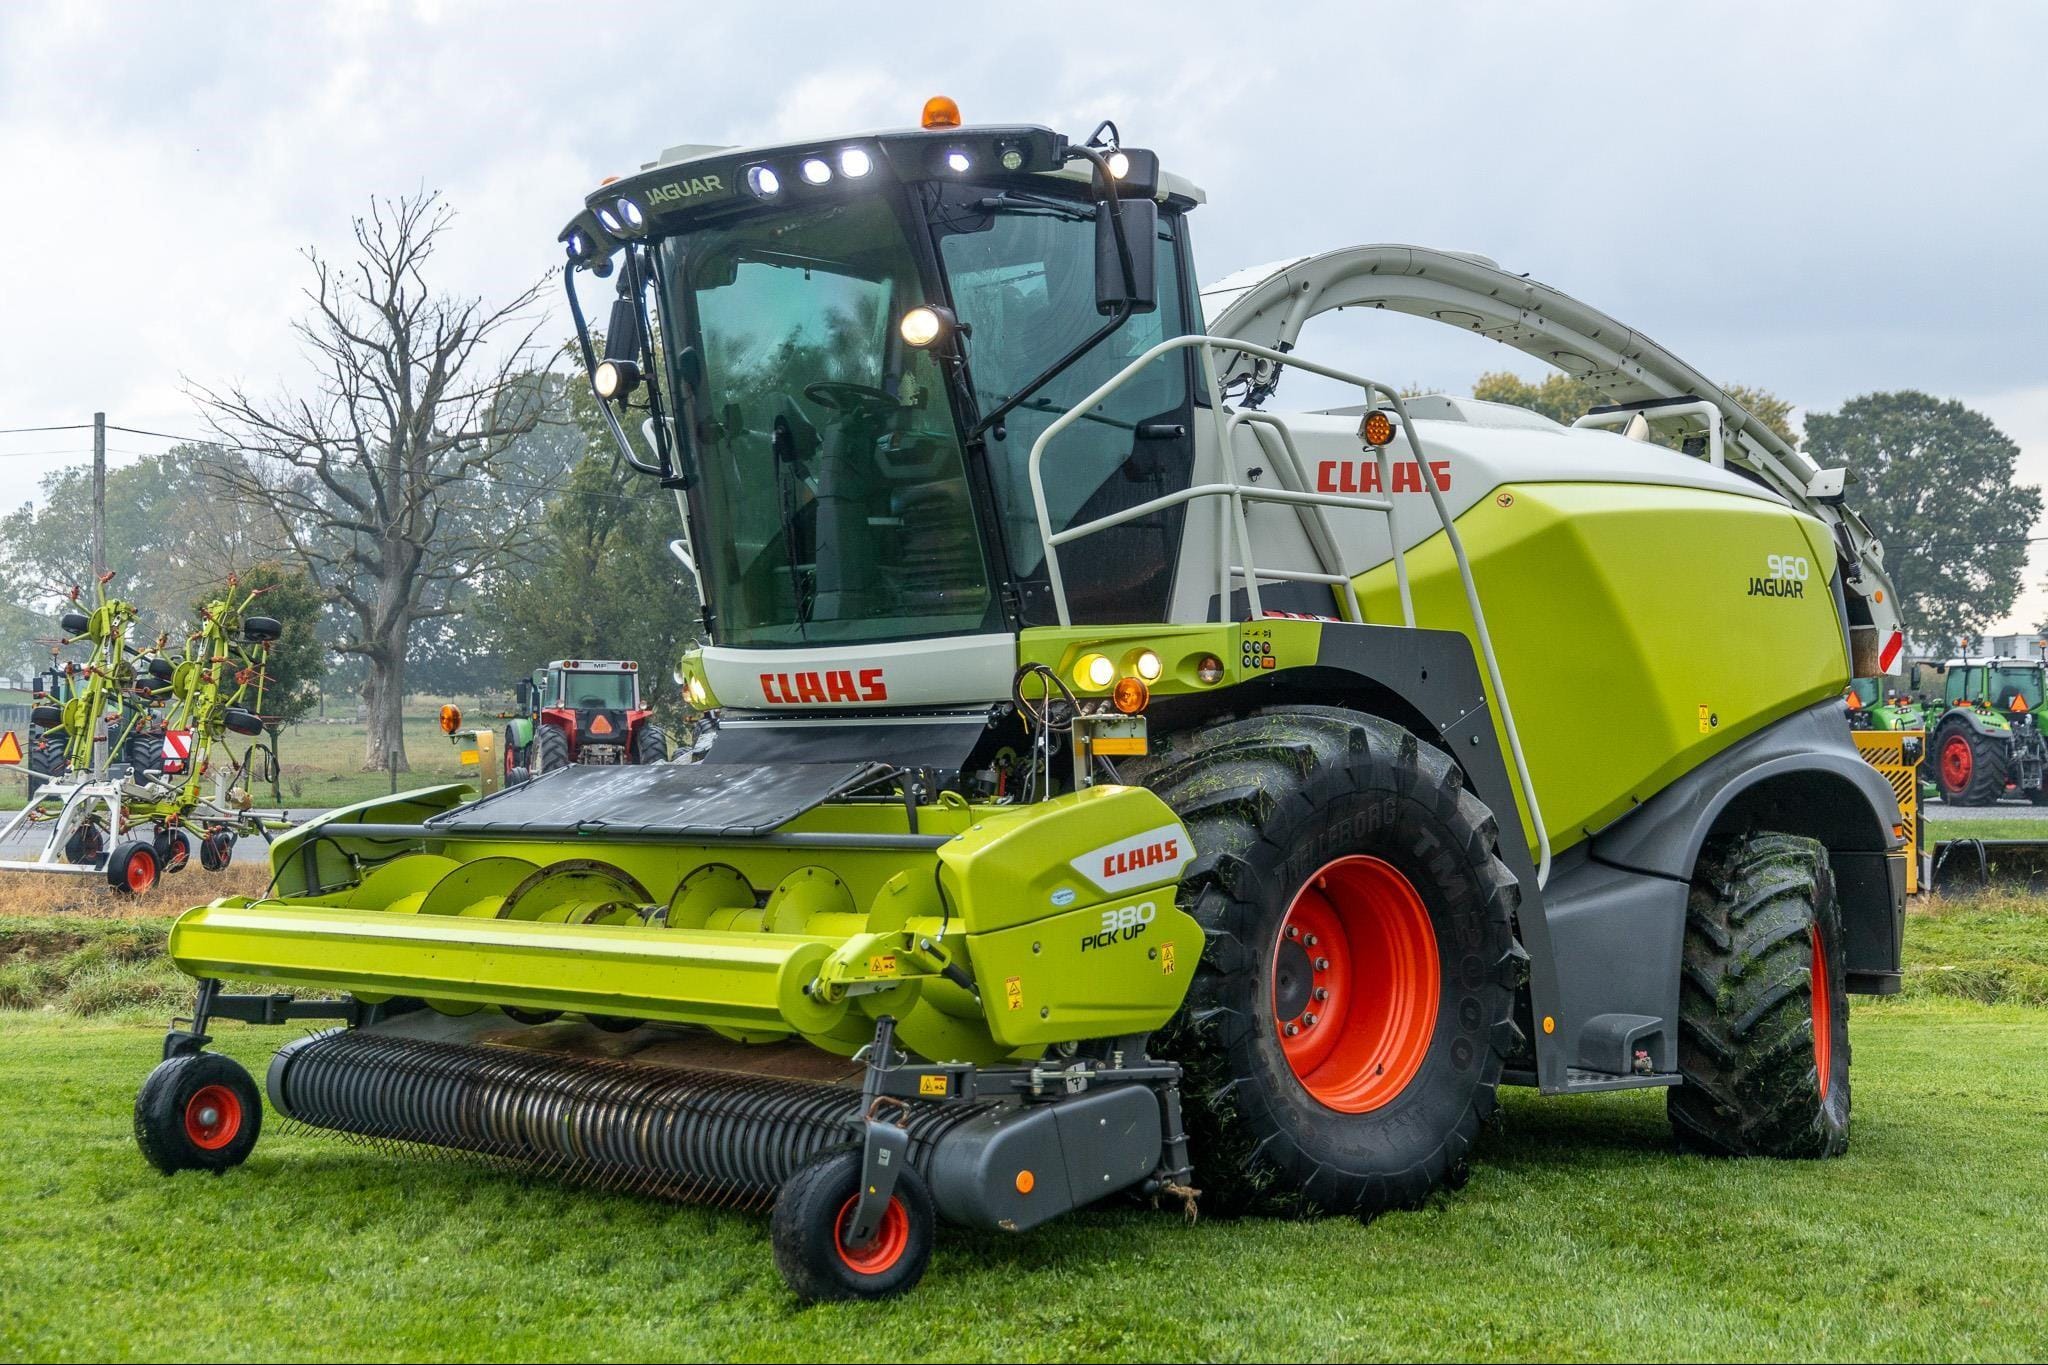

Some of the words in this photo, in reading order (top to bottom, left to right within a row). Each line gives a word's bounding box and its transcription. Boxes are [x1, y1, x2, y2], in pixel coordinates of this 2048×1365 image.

[645, 175, 724, 206] JAGUAR
[1317, 460, 1452, 493] CLAAS
[1767, 554, 1809, 581] 960
[1747, 577, 1804, 599] JAGUAR
[759, 668, 888, 703] CLAAS
[1103, 839, 1178, 878] CLAAS
[1101, 901, 1156, 934] 380
[1081, 928, 1118, 952] PICK
[1123, 923, 1146, 941] UP
